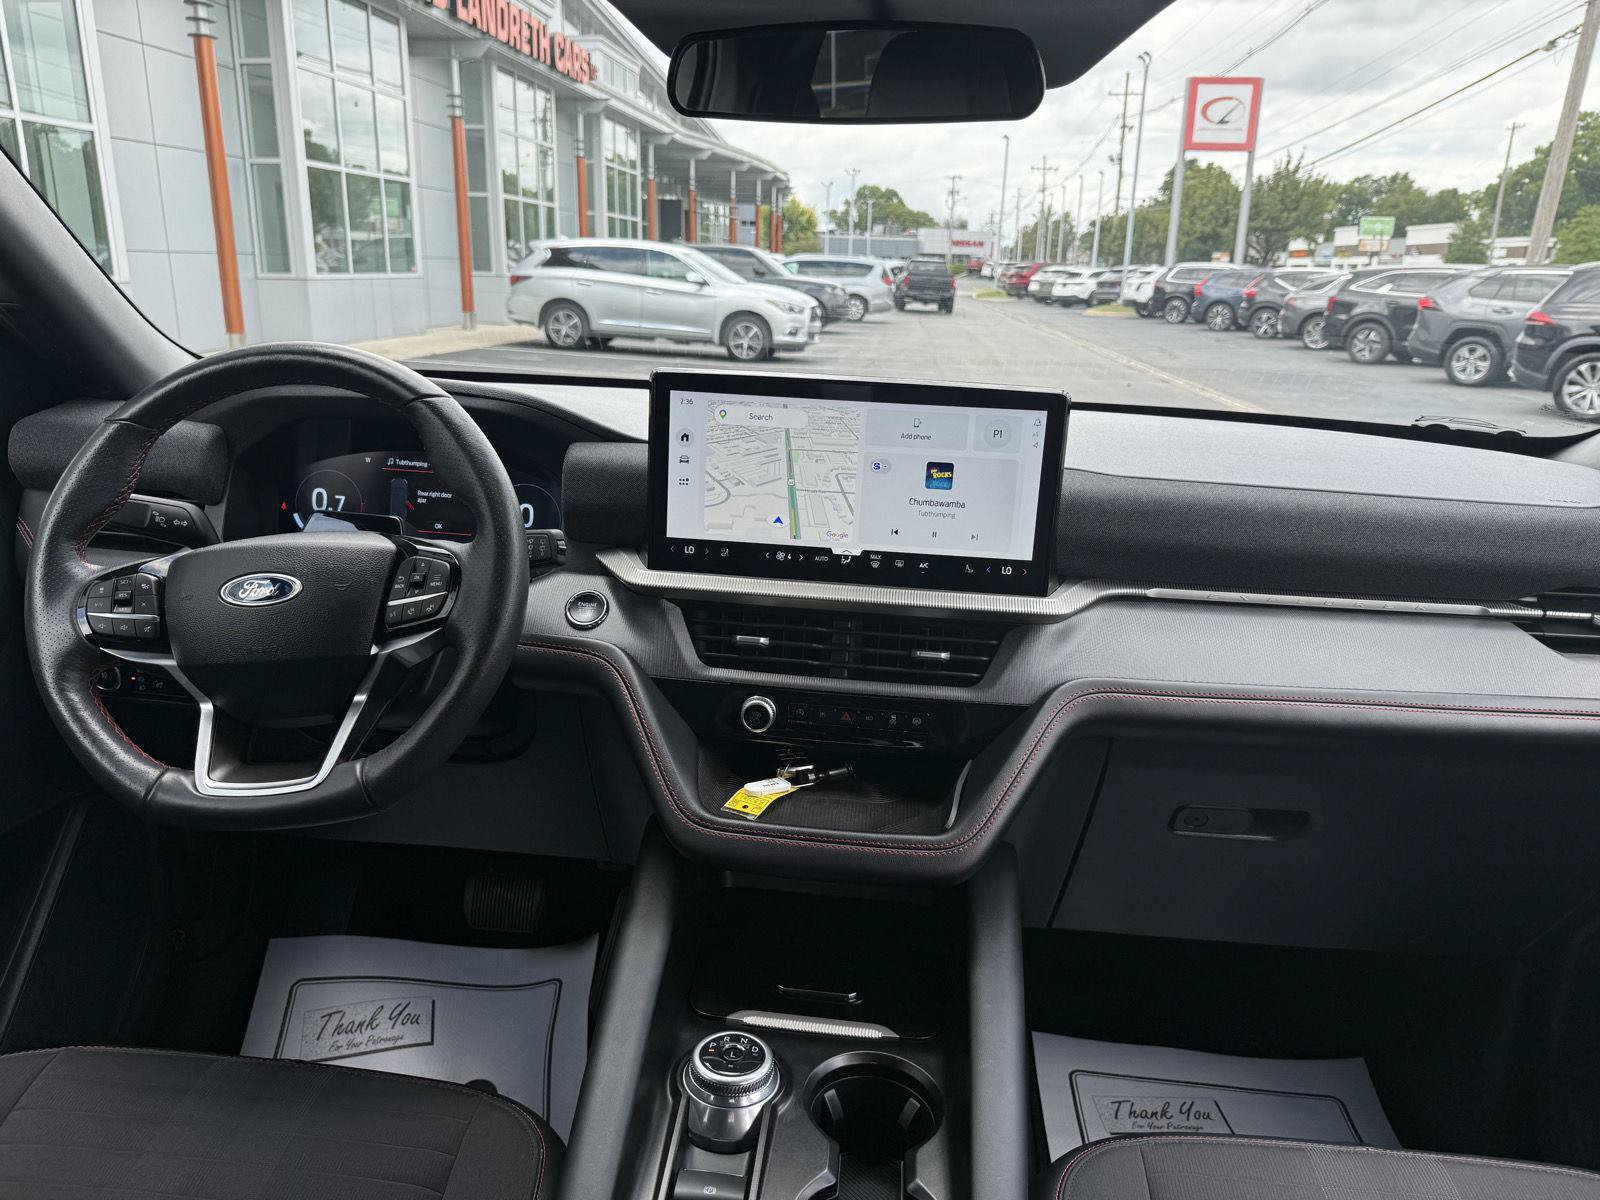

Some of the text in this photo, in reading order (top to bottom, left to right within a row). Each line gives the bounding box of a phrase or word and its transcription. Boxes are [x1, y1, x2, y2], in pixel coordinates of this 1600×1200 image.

[455, 0, 590, 84] LANDRETH CARS
[749, 412, 774, 422] Search
[900, 432, 932, 441] Add phone
[993, 429, 1003, 439] P1
[396, 459, 428, 468] Tubthumping
[417, 489, 429, 497] Rear
[312, 487, 346, 512] 0.7
[908, 497, 966, 509] Chumbawamba
[918, 510, 956, 519] Tubthumping
[826, 530, 849, 540] Google
[684, 546, 695, 555] LO
[1001, 566, 1013, 576] LO
[239, 579, 281, 600] Ford
[316, 1000, 421, 1042] Thank You
[328, 1041, 343, 1052] For
[346, 1038, 363, 1050] Your
[751, 1045, 759, 1053] D
[1110, 1099, 1214, 1123] Thank You
[1132, 1121, 1145, 1129] For
[1146, 1121, 1163, 1130] Your
